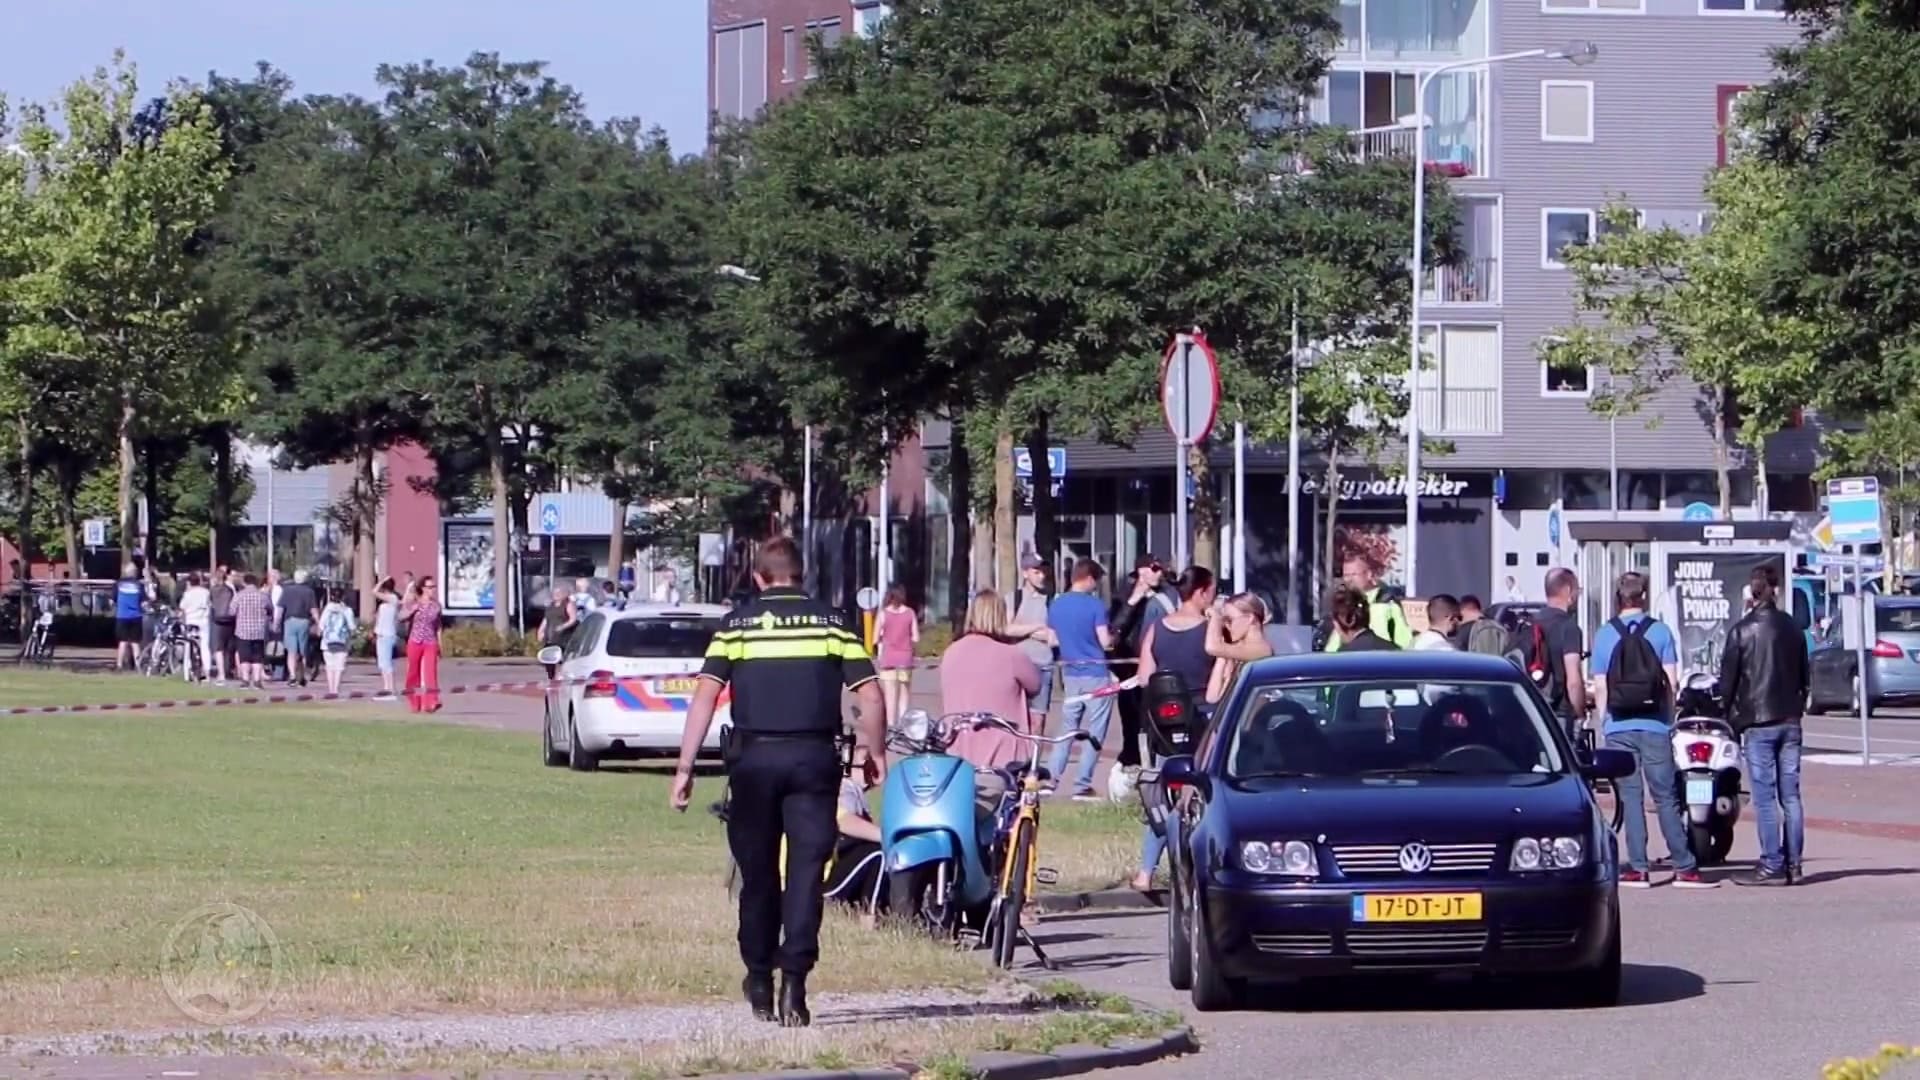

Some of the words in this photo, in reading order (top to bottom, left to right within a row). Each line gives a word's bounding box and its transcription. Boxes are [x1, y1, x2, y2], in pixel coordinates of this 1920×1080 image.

[1674, 561, 1714, 579] JOUW
[1683, 598, 1730, 620] POWER
[1376, 897, 1465, 917] 17-DT-JT
